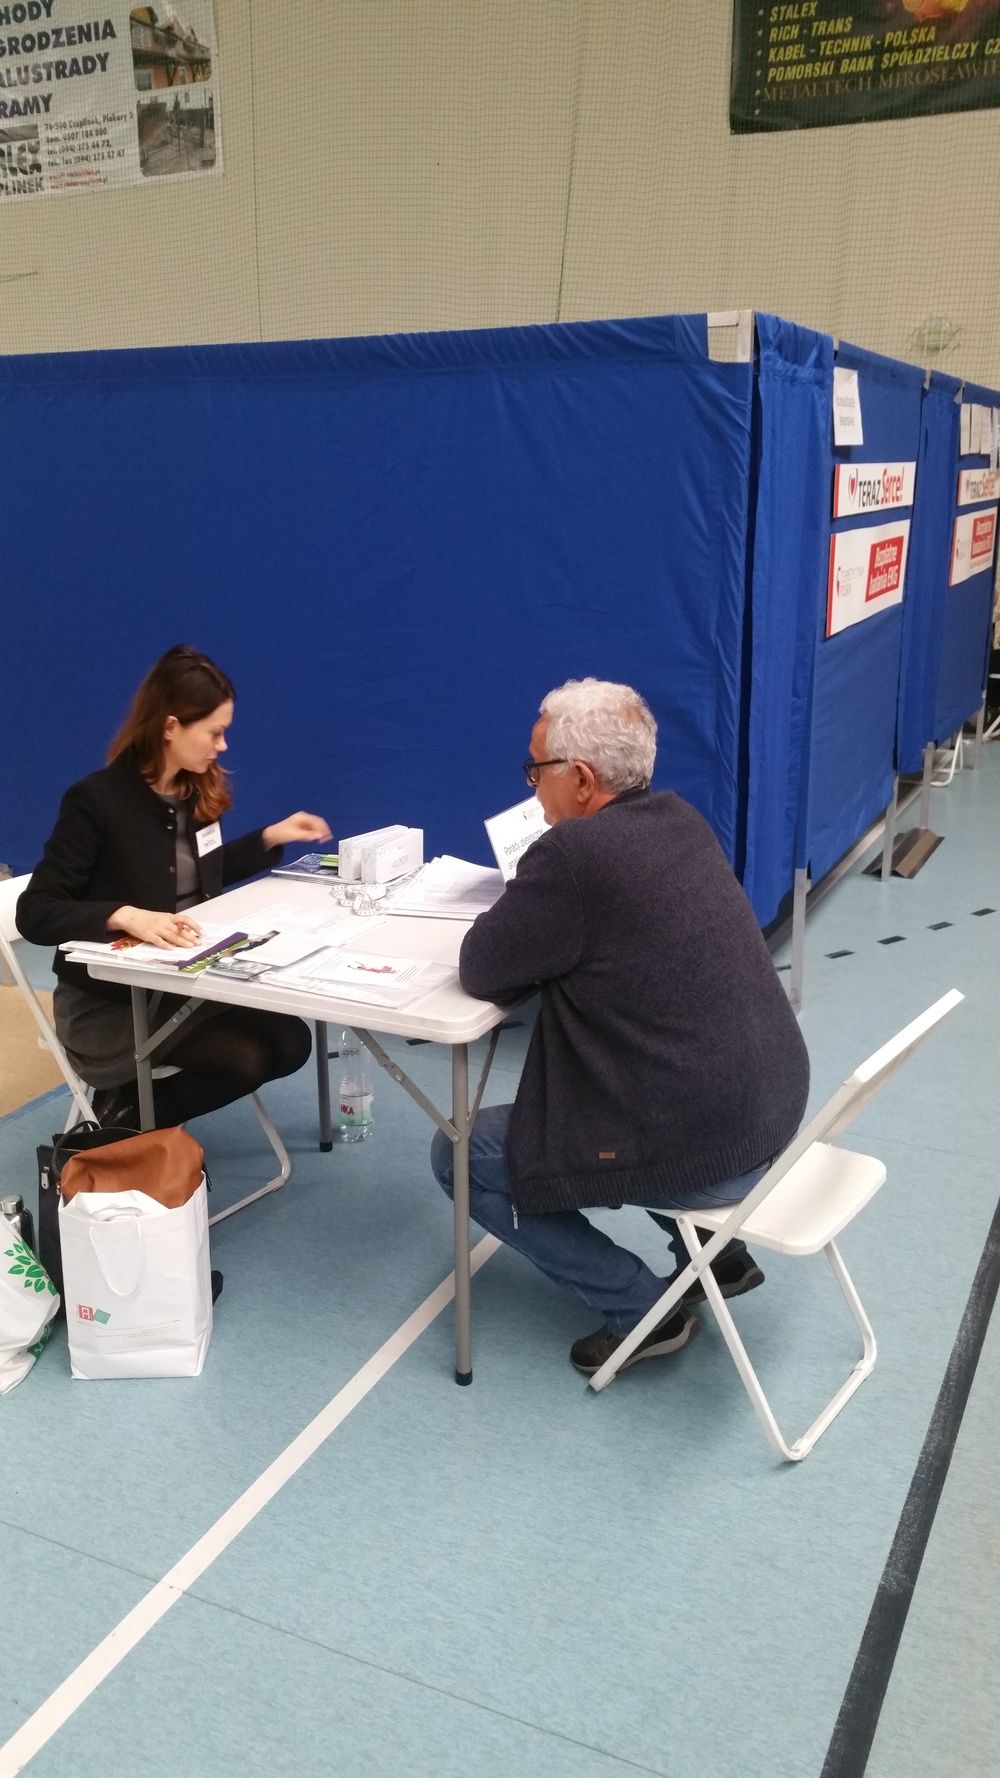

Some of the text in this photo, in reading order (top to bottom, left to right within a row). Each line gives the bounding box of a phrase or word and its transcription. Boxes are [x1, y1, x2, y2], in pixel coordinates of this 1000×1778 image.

[0, 0, 54, 26] HODY
[770, 1, 818, 22] STALEX
[769, 24, 800, 43] RICH
[811, 16, 853, 37] TRANS
[768, 43, 806, 62] KABEL
[820, 34, 874, 56] TECHNIK
[884, 25, 936, 48] POLSKA
[768, 60, 835, 82] POMORSKI
[840, 54, 876, 74] BANK
[881, 41, 979, 69] SPÓŁDZIELCZY
[0, 93, 53, 119] RAMY
[859, 466, 904, 508] TERAZ Serce!
